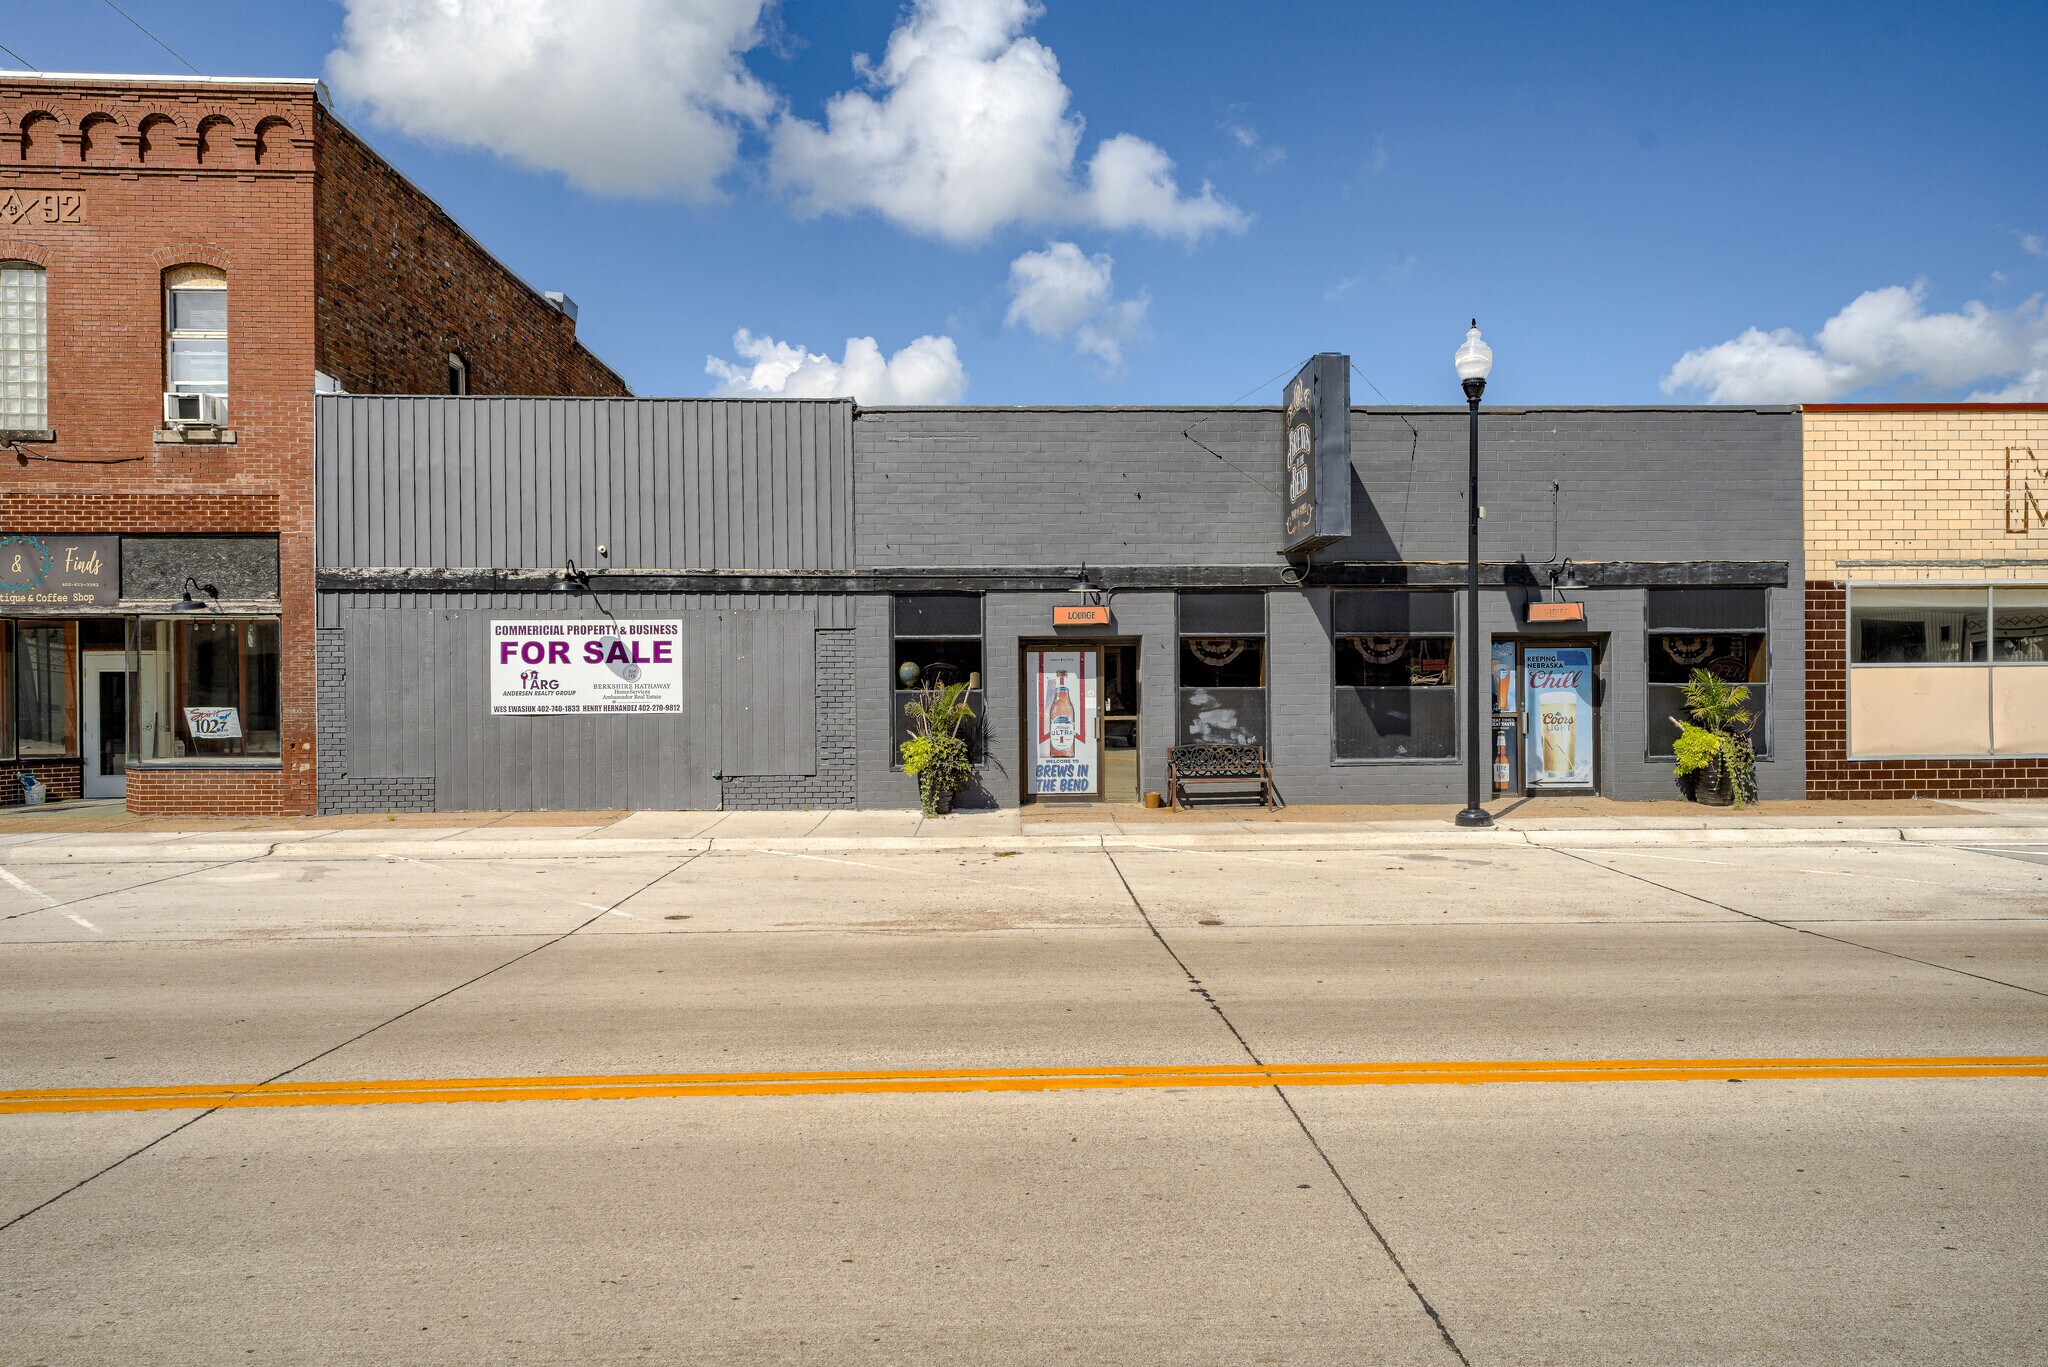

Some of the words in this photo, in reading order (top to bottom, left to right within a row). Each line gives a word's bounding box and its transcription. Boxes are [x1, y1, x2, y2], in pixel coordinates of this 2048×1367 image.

[43, 196, 80, 223] 92
[12, 554, 22, 572] &
[65, 546, 103, 574] Finds
[28, 594, 35, 602] &
[36, 593, 68, 602] Coffee
[72, 593, 95, 603] Shop
[1067, 611, 1096, 619] LOUNGE
[495, 625, 565, 635] COMMERICIAL
[567, 625, 618, 635] PROPERTY
[619, 626, 627, 635] &
[629, 624, 678, 635] BUSINESS
[500, 641, 572, 665] FOR
[583, 640, 673, 665] SALE
[530, 680, 560, 690] ARG
[1529, 669, 1583, 688] Chill
[190, 708, 233, 721] Spirit
[1543, 712, 1575, 725] Coors
[195, 718, 227, 734] 102.7
[1036, 764, 1075, 777] BREWS
[1077, 764, 1089, 777] IN
[1036, 778, 1057, 792] THE
[1059, 778, 1089, 792] BEND
